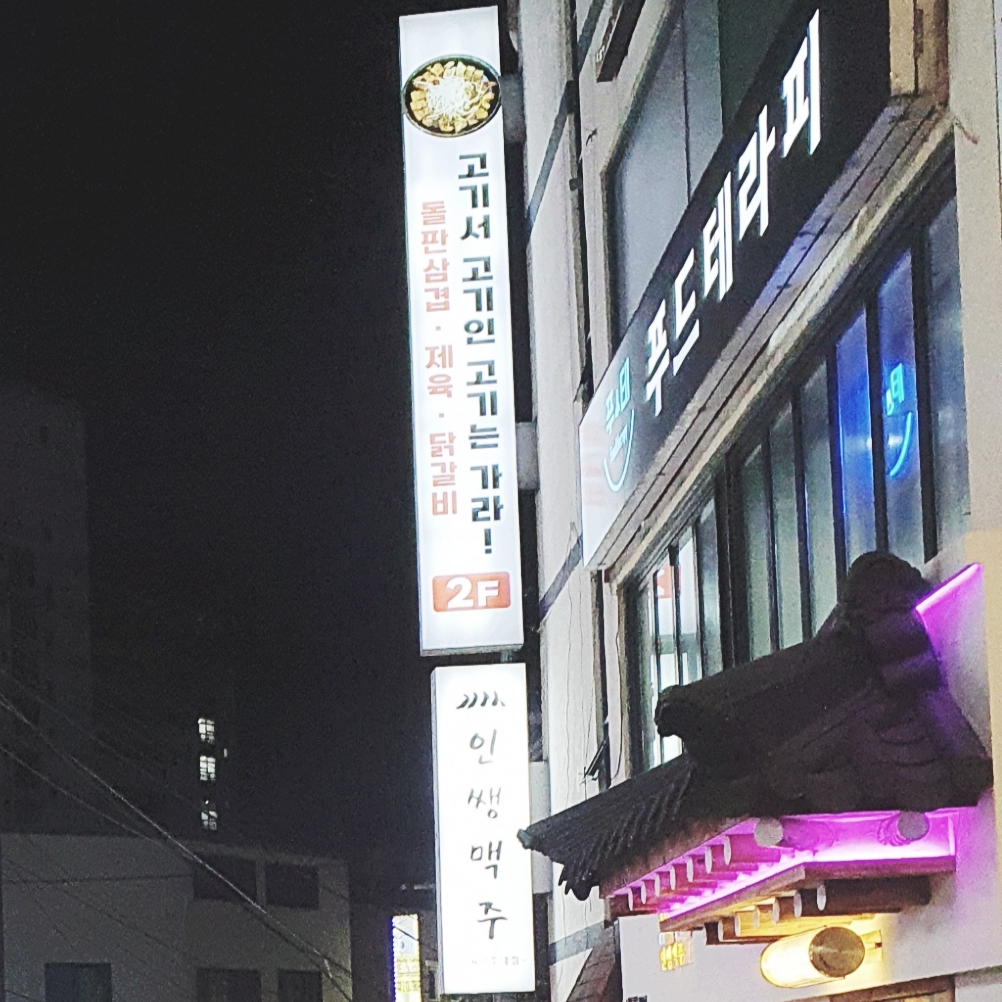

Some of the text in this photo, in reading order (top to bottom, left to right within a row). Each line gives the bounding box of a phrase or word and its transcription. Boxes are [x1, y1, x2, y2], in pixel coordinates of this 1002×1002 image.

[458, 151, 504, 554] 고기서 고기인 고기는 가라!
[645, 8, 821, 416] 푸드테라피
[445, 576, 500, 610] 2F
